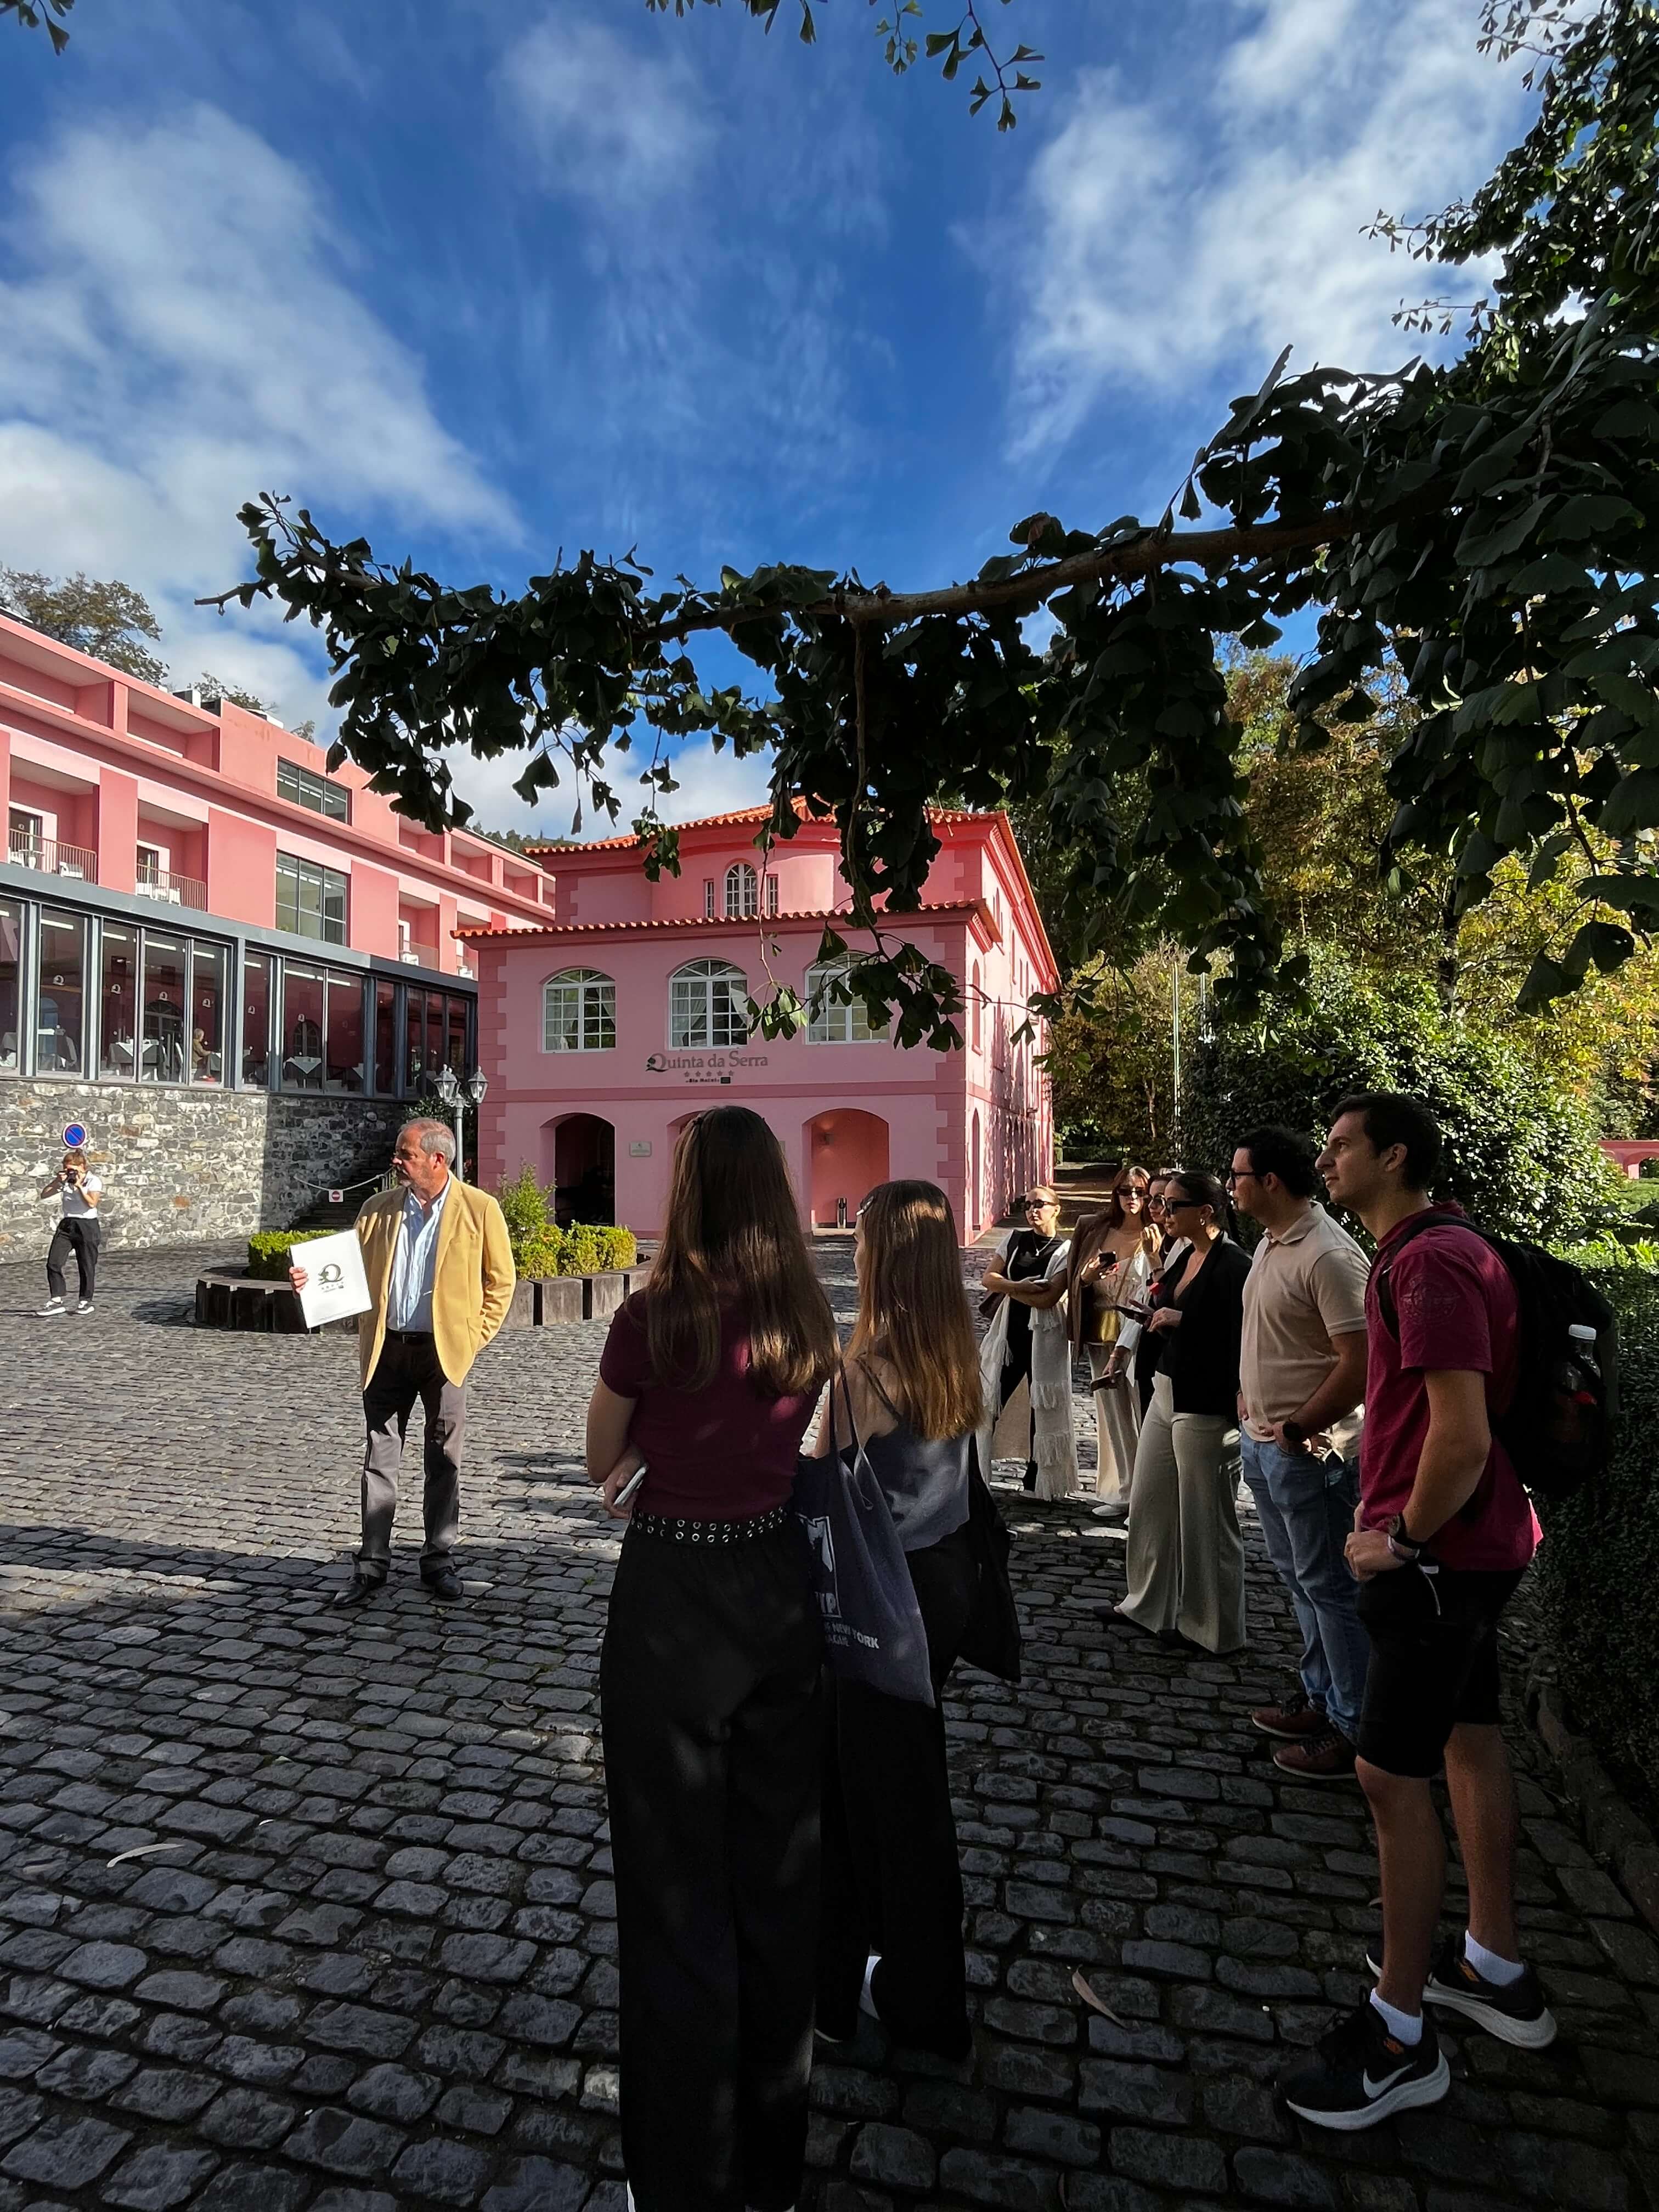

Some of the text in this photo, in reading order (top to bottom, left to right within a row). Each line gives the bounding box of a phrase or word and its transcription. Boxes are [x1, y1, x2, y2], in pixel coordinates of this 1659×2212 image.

[646, 1050, 768, 1072] Quinta da Serra
[851, 1628, 879, 1649] YORK
